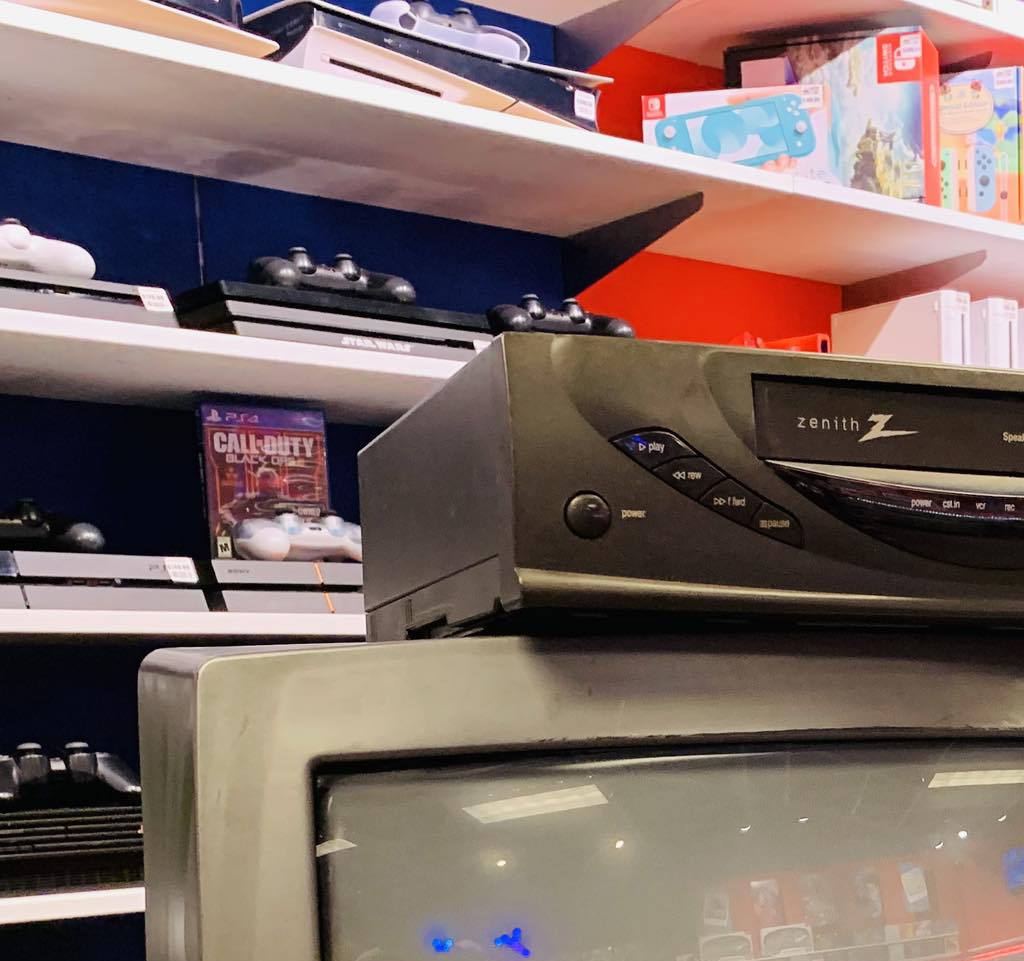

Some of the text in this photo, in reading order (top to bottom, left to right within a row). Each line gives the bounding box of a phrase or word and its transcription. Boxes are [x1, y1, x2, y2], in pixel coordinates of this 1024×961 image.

[341, 336, 411, 352] STAR WARS
[225, 412, 260, 424] PS4
[796, 416, 860, 432] zenith
[213, 431, 315, 458] CALL DUTY
[648, 441, 666, 454] play
[225, 453, 267, 465] BLACK
[687, 471, 702, 481] rew
[911, 499, 932, 509] power
[975, 501, 986, 511] vcr
[1004, 503, 1016, 513] rec
[621, 508, 647, 520] power
[767, 519, 790, 530] pause
[219, 542, 230, 553] M
